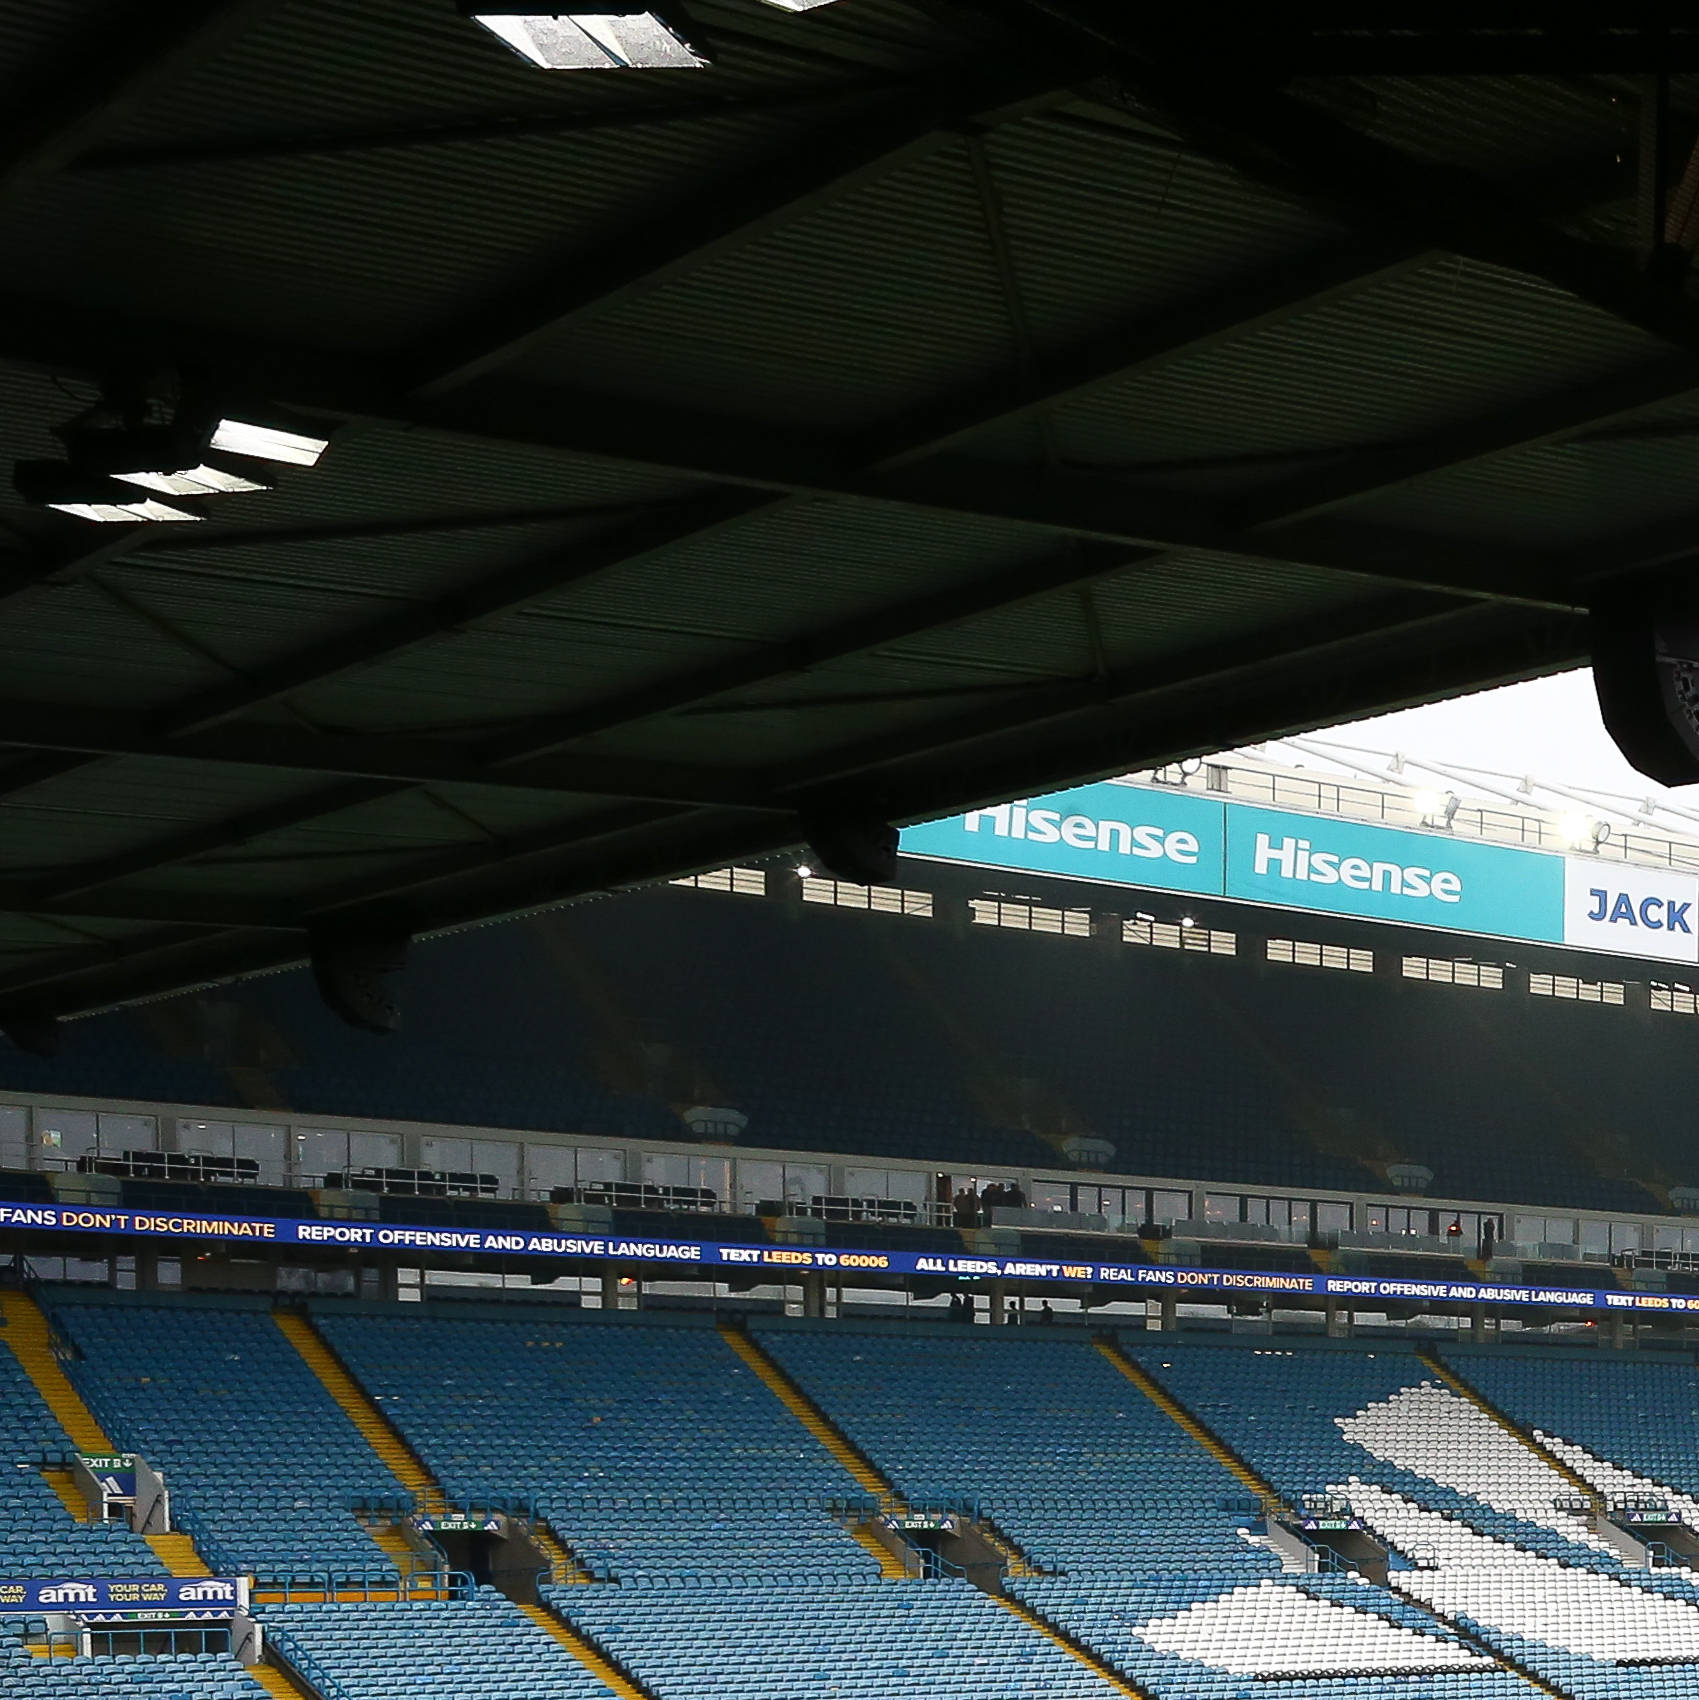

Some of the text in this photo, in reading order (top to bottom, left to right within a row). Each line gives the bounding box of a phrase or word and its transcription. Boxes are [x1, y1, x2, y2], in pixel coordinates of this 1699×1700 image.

[964, 801, 1199, 865] Hisense
[1254, 833, 1461, 903] Hisense
[1588, 889, 1693, 934] JACK
[0, 1208, 275, 1237] FANS DON'T DISCRIMINATE
[298, 1225, 700, 1260] REPORT OFFENSIVE AND ABUSIVE LANGUAGE
[720, 1249, 888, 1267] TEXT LEEDS TO 60006
[916, 1257, 1093, 1278] ALL LEEDS, AREN'T WE?
[1100, 1267, 1312, 1290] REAL FANS DON'T DISCRIMINATE
[1327, 1279, 1593, 1305] REPORT OFFENSIVE AND ABUSIVE LANGUAGE
[1606, 1296, 1634, 1307] TEXT
[1635, 1297, 1668, 1308] LEEDS
[1670, 1298, 1686, 1309] TO
[39, 1584, 97, 1603] amt
[108, 1584, 167, 1593] YOUR CAR.
[141, 1593, 166, 1601] WAY
[179, 1583, 234, 1601] amt
